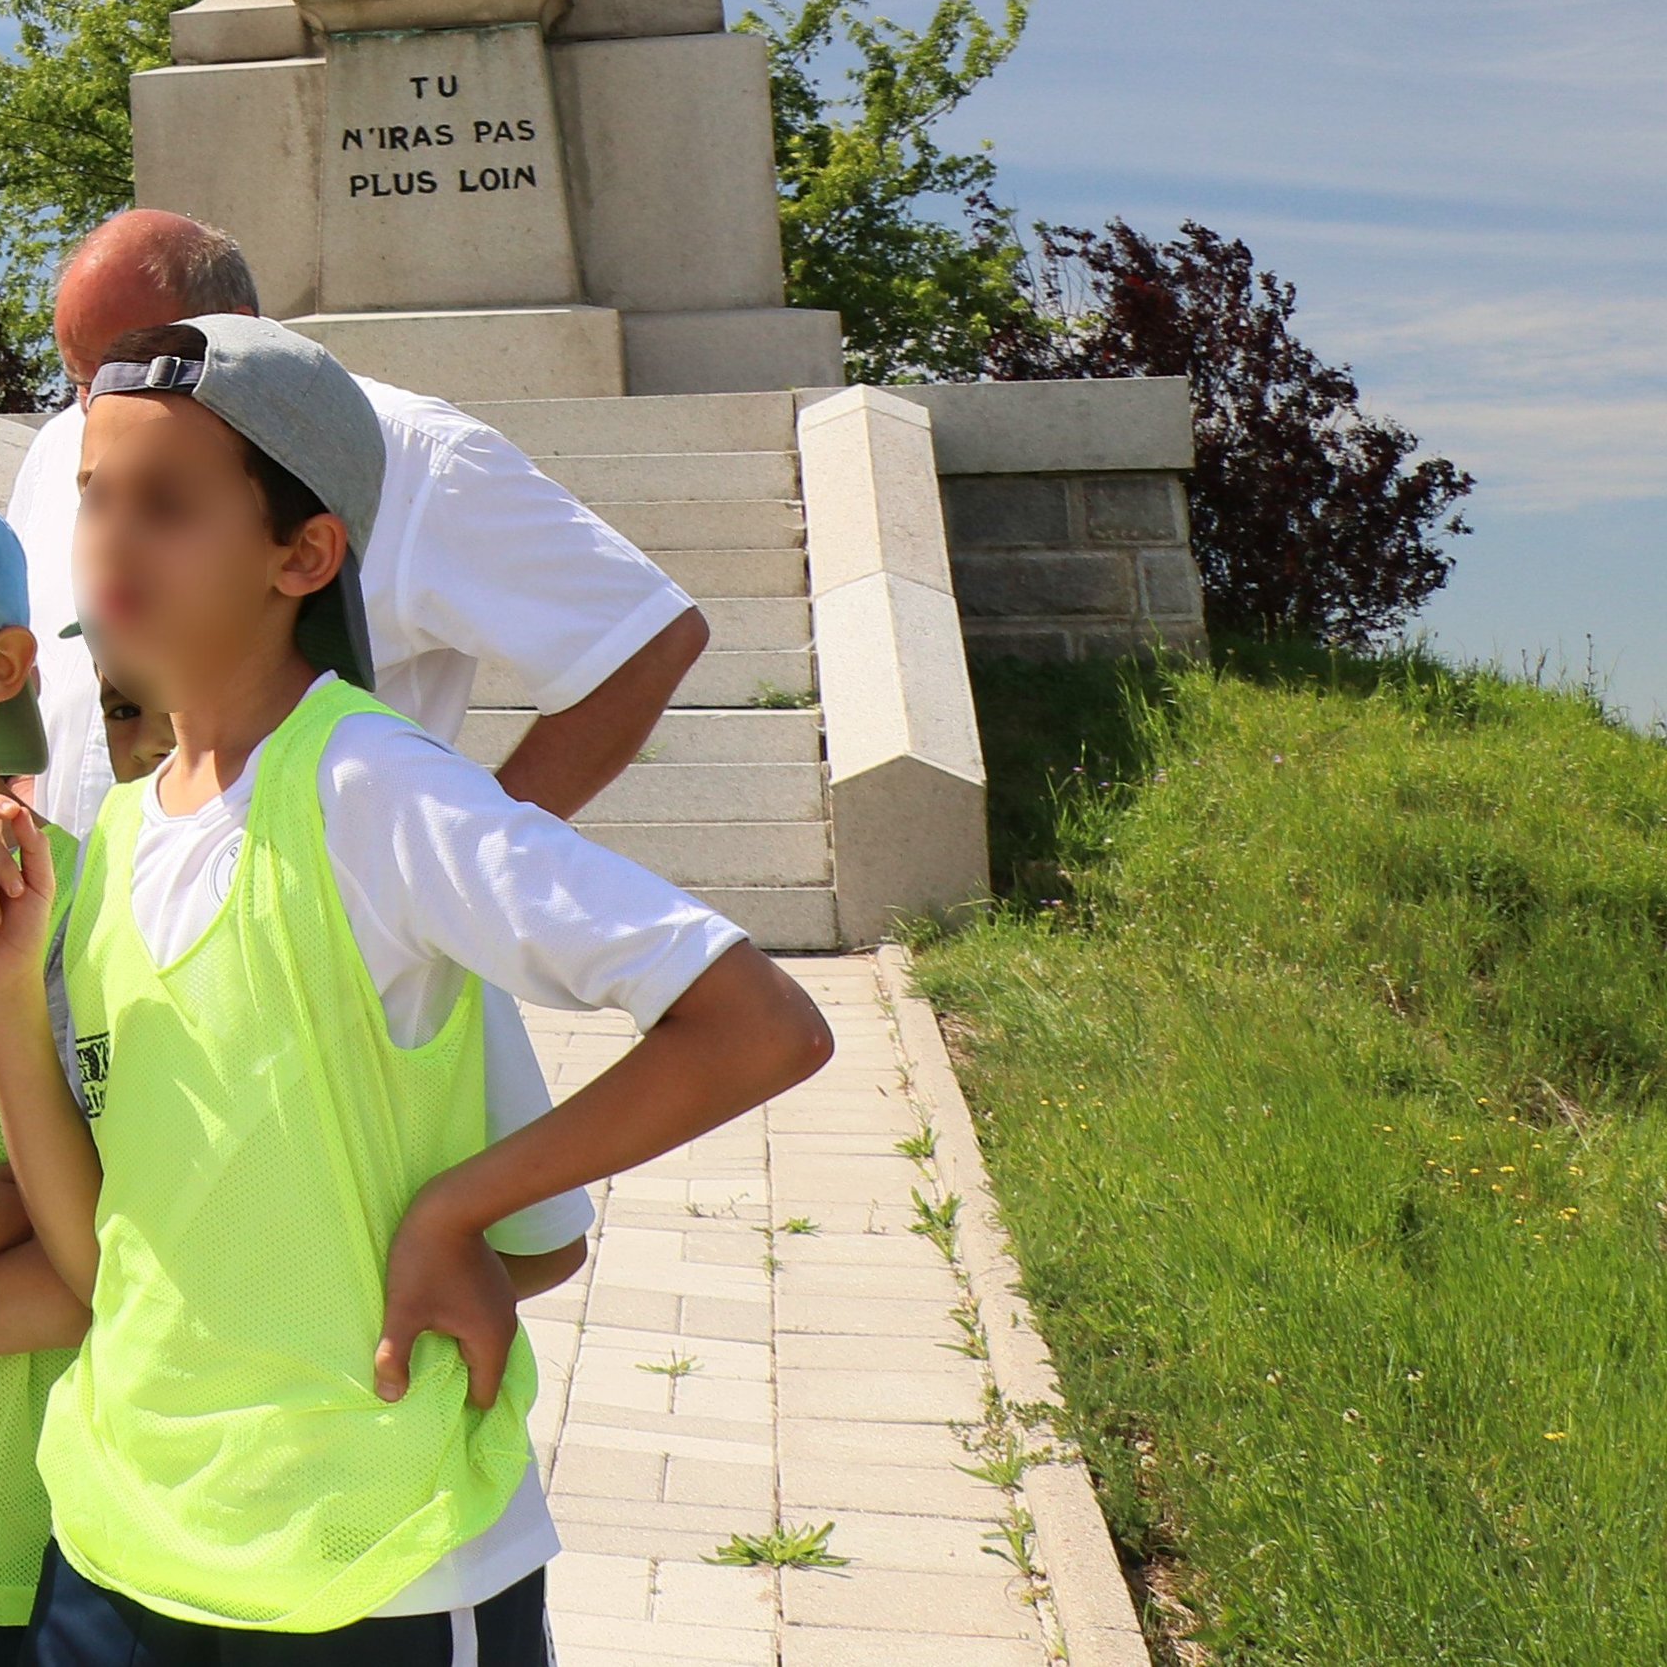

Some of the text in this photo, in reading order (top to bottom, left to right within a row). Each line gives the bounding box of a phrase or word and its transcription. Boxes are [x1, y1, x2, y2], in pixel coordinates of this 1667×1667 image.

[410, 75, 458, 98] TU
[342, 119, 535, 151] N'IRAS PAS
[350, 165, 537, 197] PLUS LOIN
